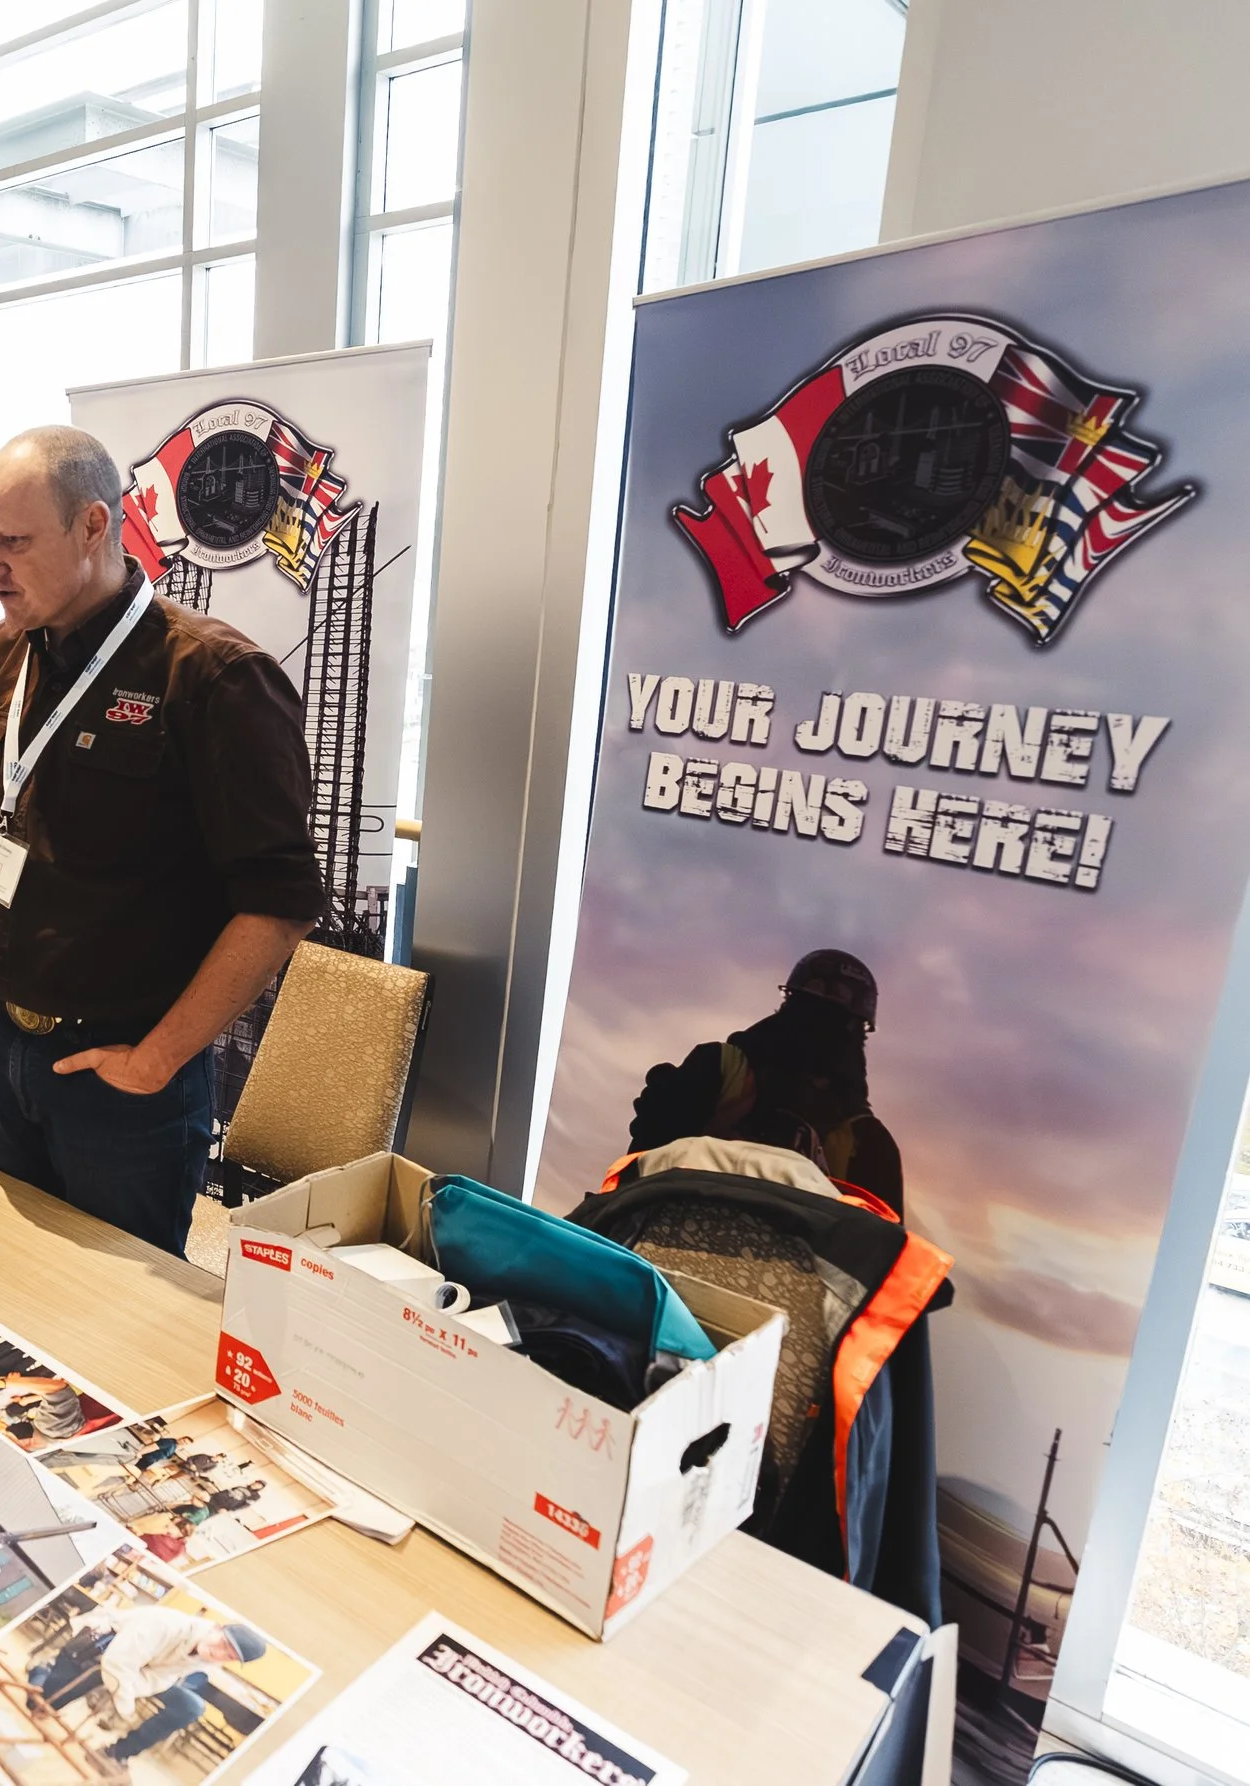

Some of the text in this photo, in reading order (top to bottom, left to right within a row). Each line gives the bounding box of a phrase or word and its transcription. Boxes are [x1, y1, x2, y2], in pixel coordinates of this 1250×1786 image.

[844, 329, 1000, 384] Local 97
[192, 410, 269, 438] Local 97
[112, 687, 161, 704] Ironworkers
[106, 708, 153, 725] 97
[626, 672, 1172, 793] YOUR JOURNEY
[641, 750, 1115, 890] BEGINS HERE!
[244, 1243, 335, 1281] STAPLES copies
[453, 1334, 466, 1350] 11
[235, 1351, 253, 1372] 92
[233, 1368, 251, 1388] 20
[289, 1402, 313, 1422] blanc
[291, 1388, 345, 1427] 5000 feuilles
